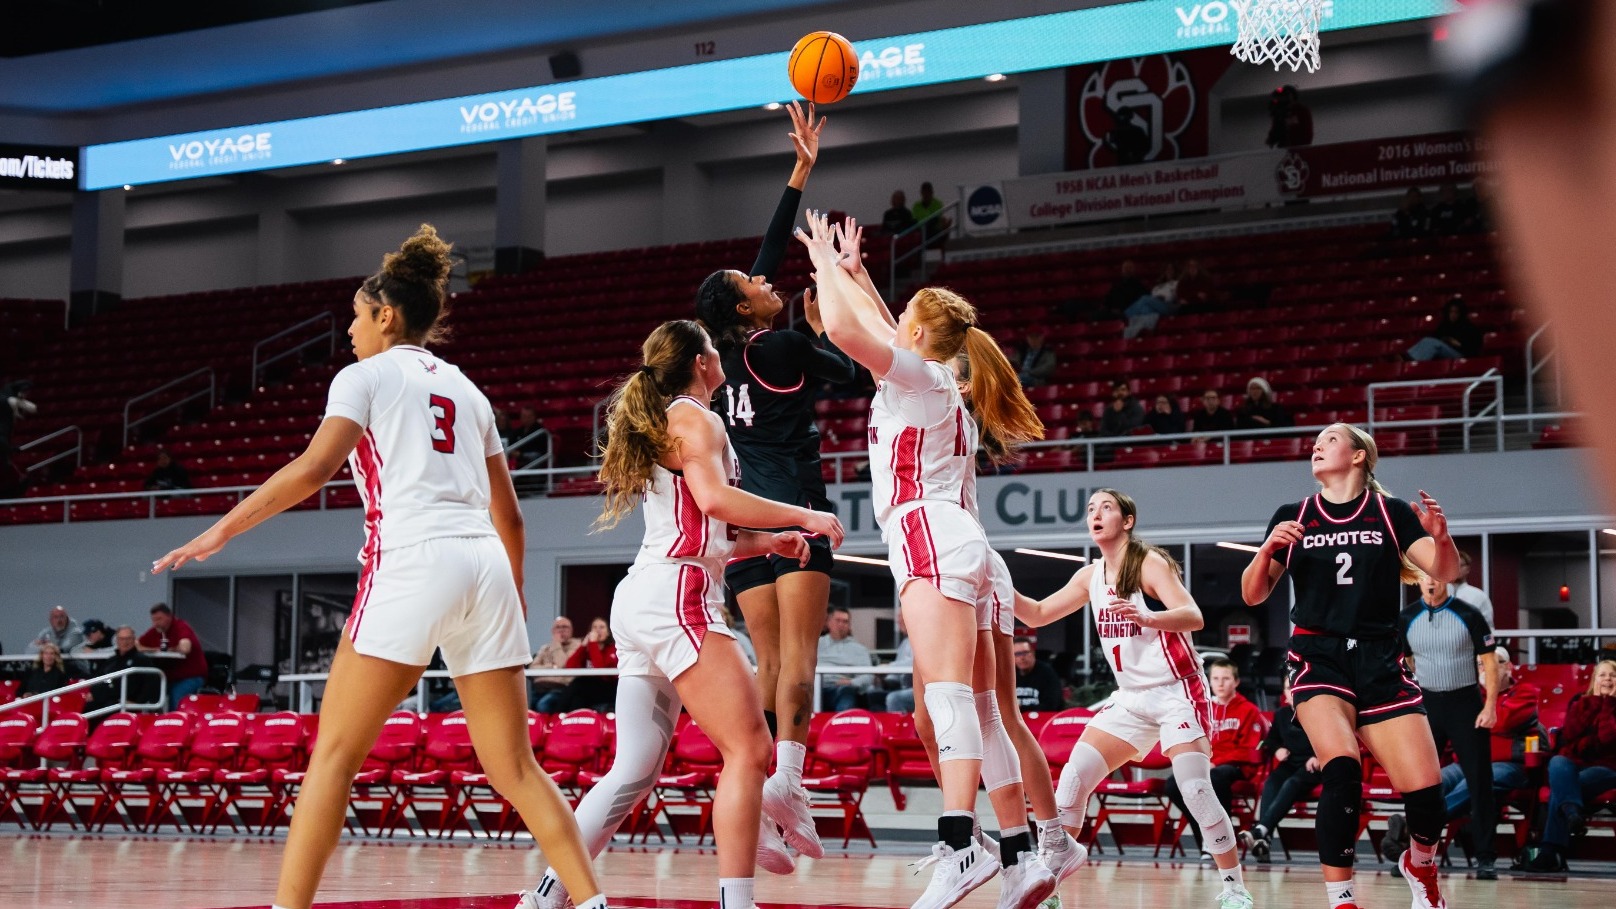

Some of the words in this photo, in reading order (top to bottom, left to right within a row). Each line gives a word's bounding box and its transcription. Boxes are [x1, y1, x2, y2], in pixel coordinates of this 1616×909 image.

[694, 41, 716, 56] 112
[859, 43, 925, 71] AGE
[460, 91, 577, 124] VOYAGE
[169, 132, 272, 161] VOYAGE
[1377, 143, 1411, 161] 2016
[1413, 138, 1472, 156] Women's
[1056, 181, 1084, 195] 1958
[1086, 177, 1118, 192] NCAA
[1119, 172, 1153, 189] Men's
[1154, 164, 1219, 184] Basketball
[1321, 167, 1377, 189] National
[1380, 161, 1446, 181] Invitation
[970, 203, 1003, 217] NCAA
[1029, 202, 1072, 219] College
[1074, 197, 1122, 214] Division
[1124, 191, 1176, 208] National
[1178, 184, 1245, 203] Champions
[725, 383, 756, 427] 14
[428, 392, 457, 454] 3
[995, 482, 1099, 527] CLU
[1303, 530, 1383, 549] COYOTES
[1335, 552, 1354, 585] 2
[1112, 644, 1123, 673] 1
